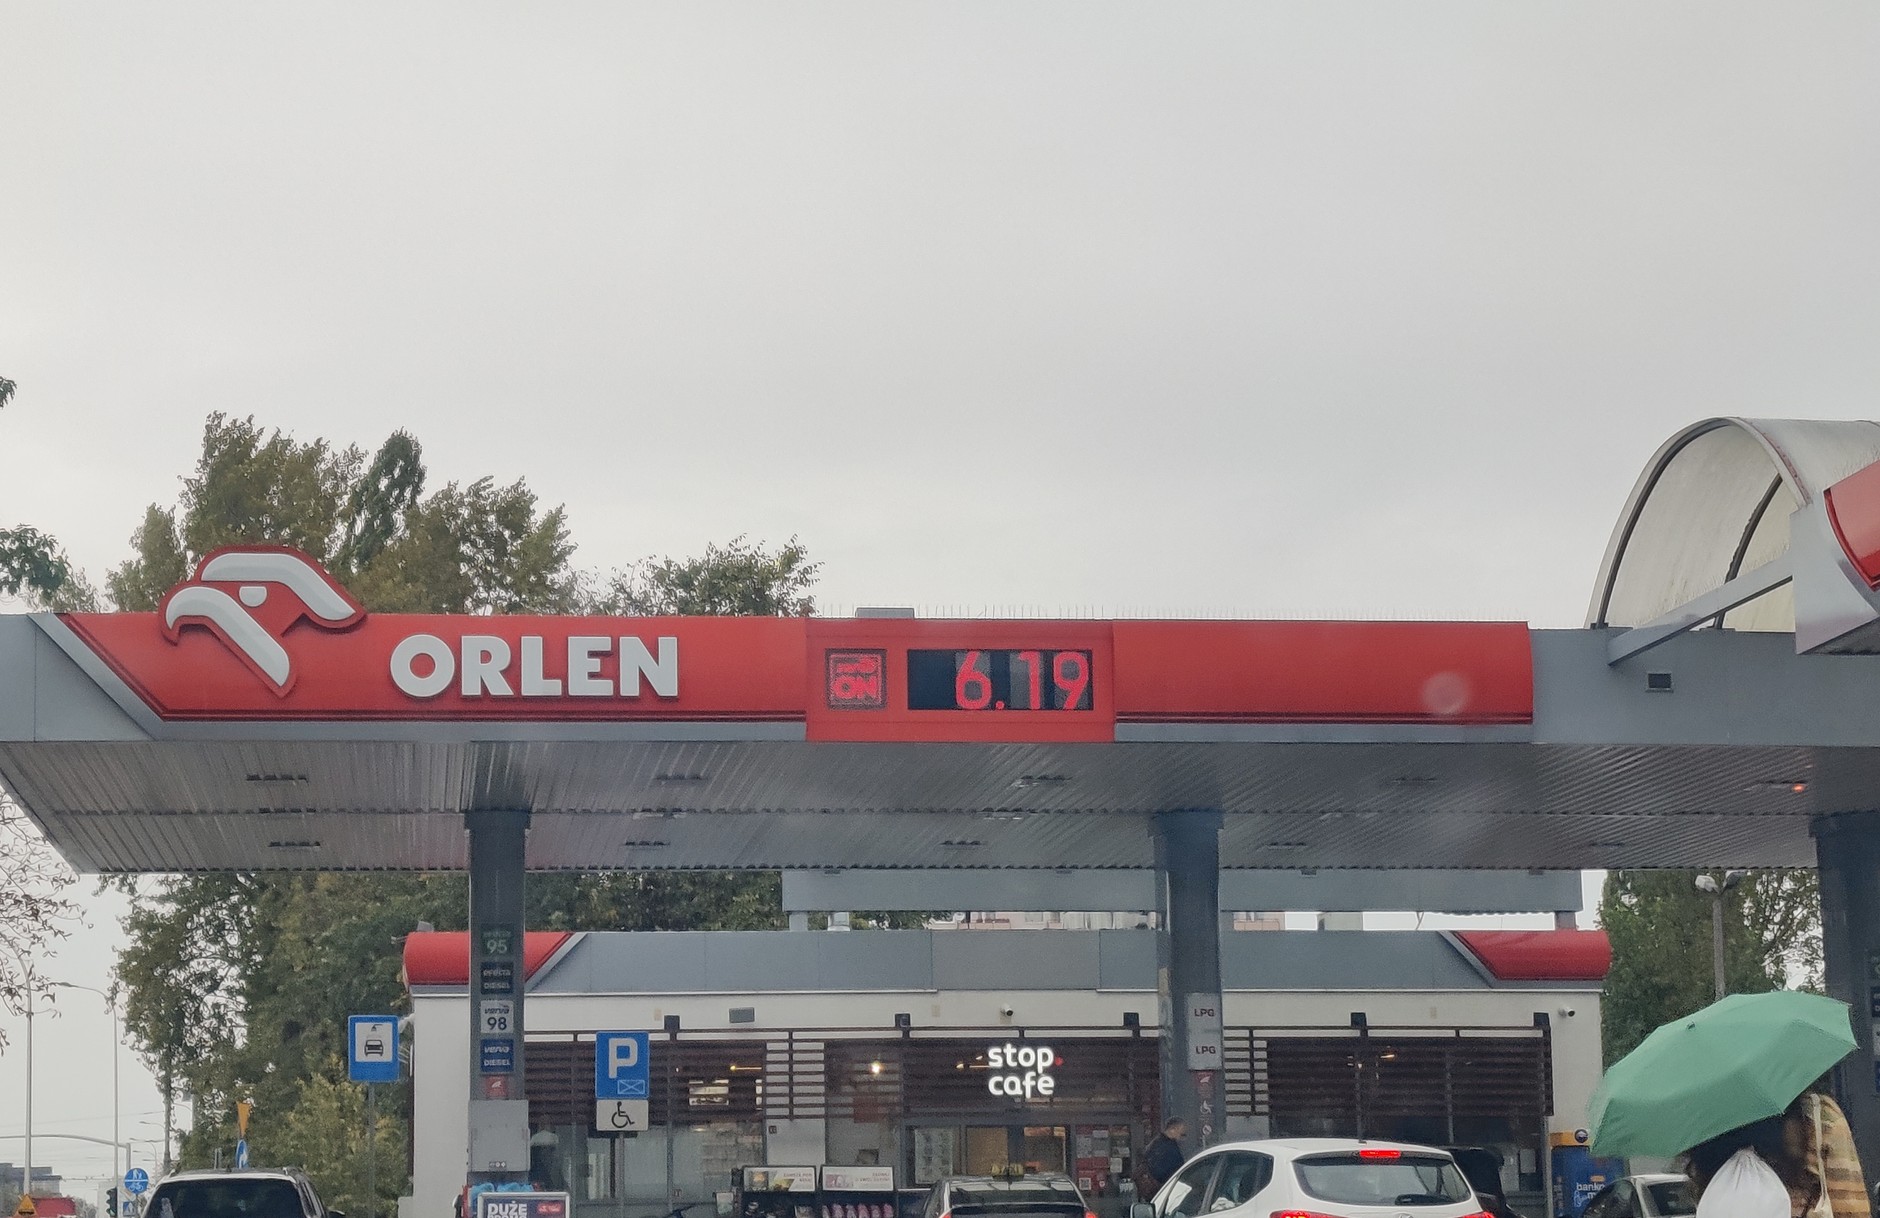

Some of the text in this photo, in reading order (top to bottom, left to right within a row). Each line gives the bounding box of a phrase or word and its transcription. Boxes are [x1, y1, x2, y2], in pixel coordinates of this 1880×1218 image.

[390, 634, 678, 698] ORLEN
[955, 650, 1089, 710] 6.19
[487, 939, 508, 954] 95
[1194, 1008, 1216, 1017] LPG
[487, 1016, 507, 1031] 98
[608, 1037, 638, 1079] P
[1195, 1045, 1217, 1055] LPG
[483, 1059, 511, 1067] DIESEL
[988, 1071, 1055, 1099] cafe
[487, 1200, 528, 1217] DUŻE
